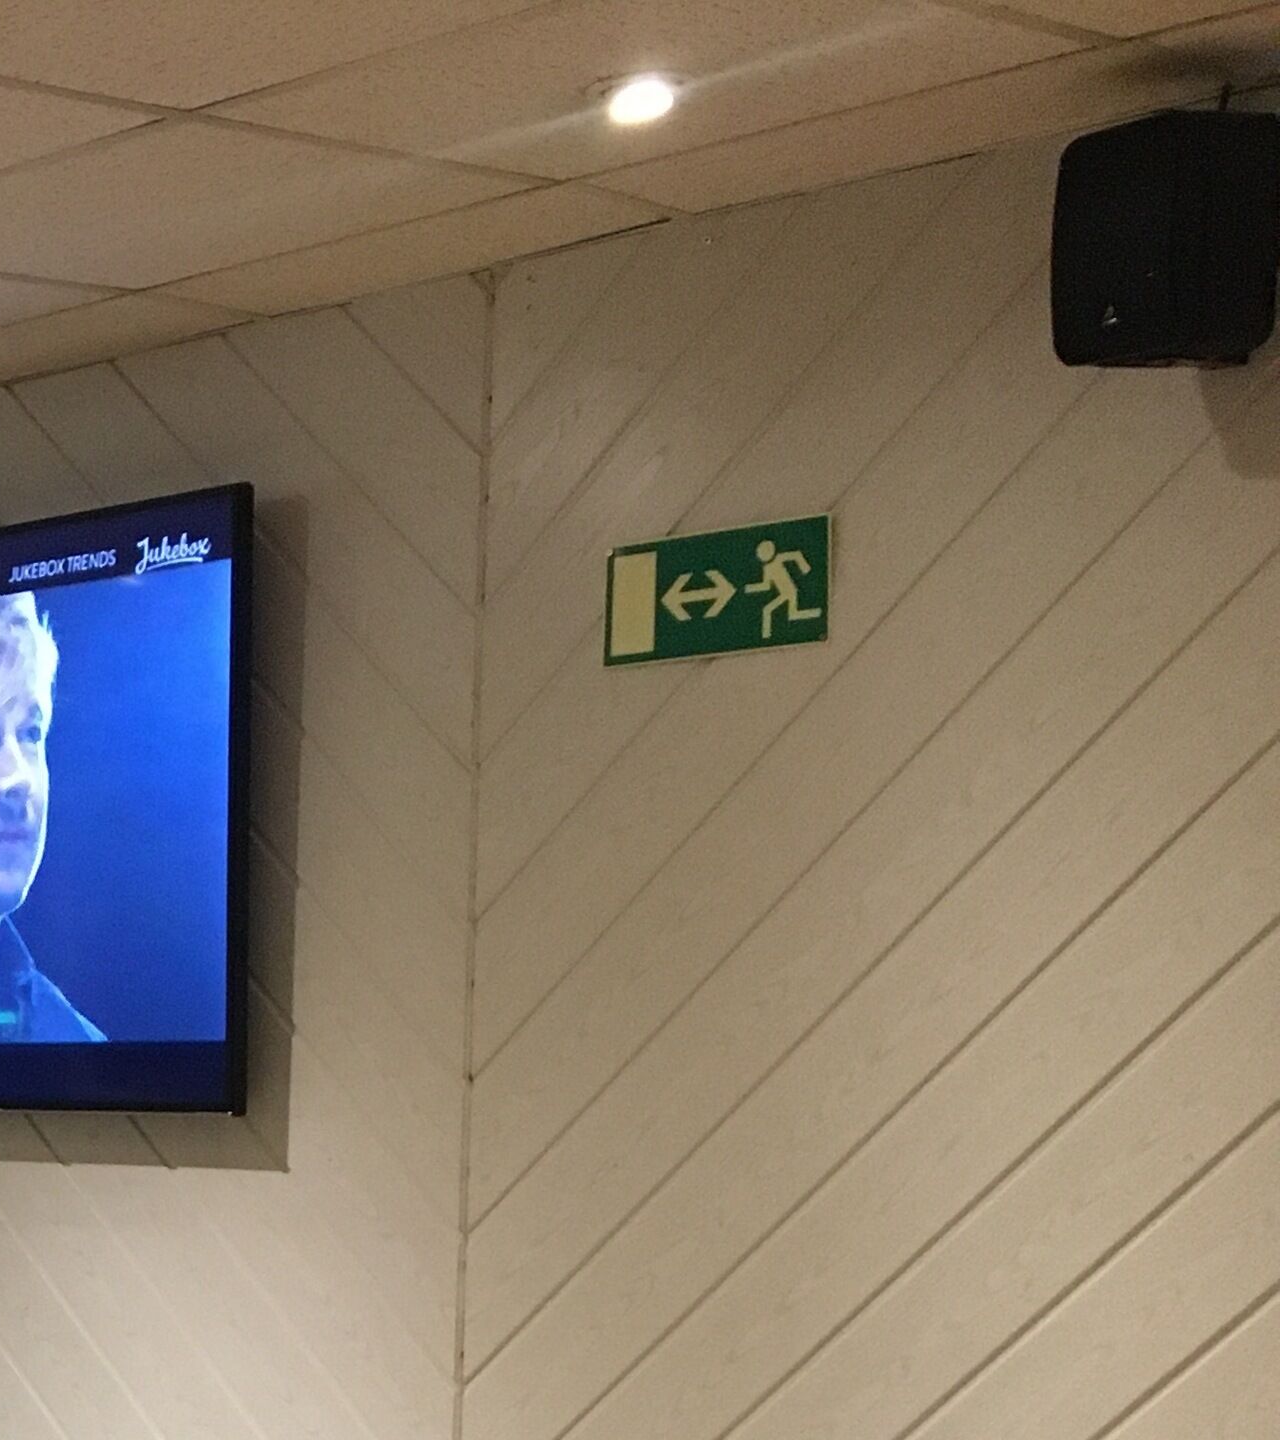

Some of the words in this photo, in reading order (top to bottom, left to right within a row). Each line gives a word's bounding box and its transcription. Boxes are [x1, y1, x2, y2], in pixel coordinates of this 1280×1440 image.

[8, 557, 65, 583] JUKEBOX
[67, 549, 117, 573] TRENDS
[134, 532, 211, 575] Jukebox
